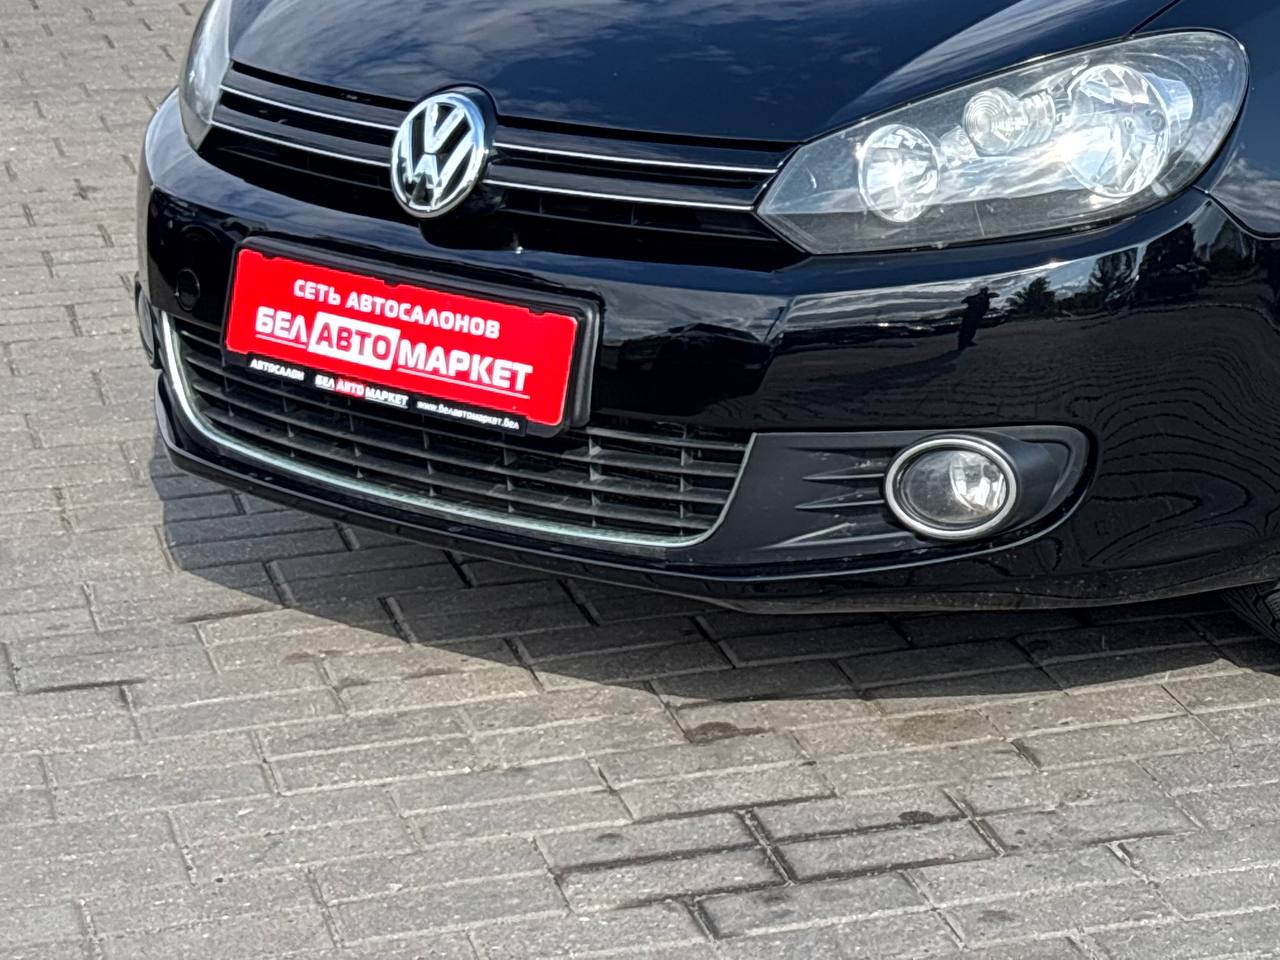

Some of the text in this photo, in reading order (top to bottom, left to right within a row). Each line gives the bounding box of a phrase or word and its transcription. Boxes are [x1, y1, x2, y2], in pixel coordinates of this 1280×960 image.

[293, 279, 500, 339] СЕТЬ АВТОСАЛОНОВ
[250, 358, 305, 382] АВТОСАЛОН
